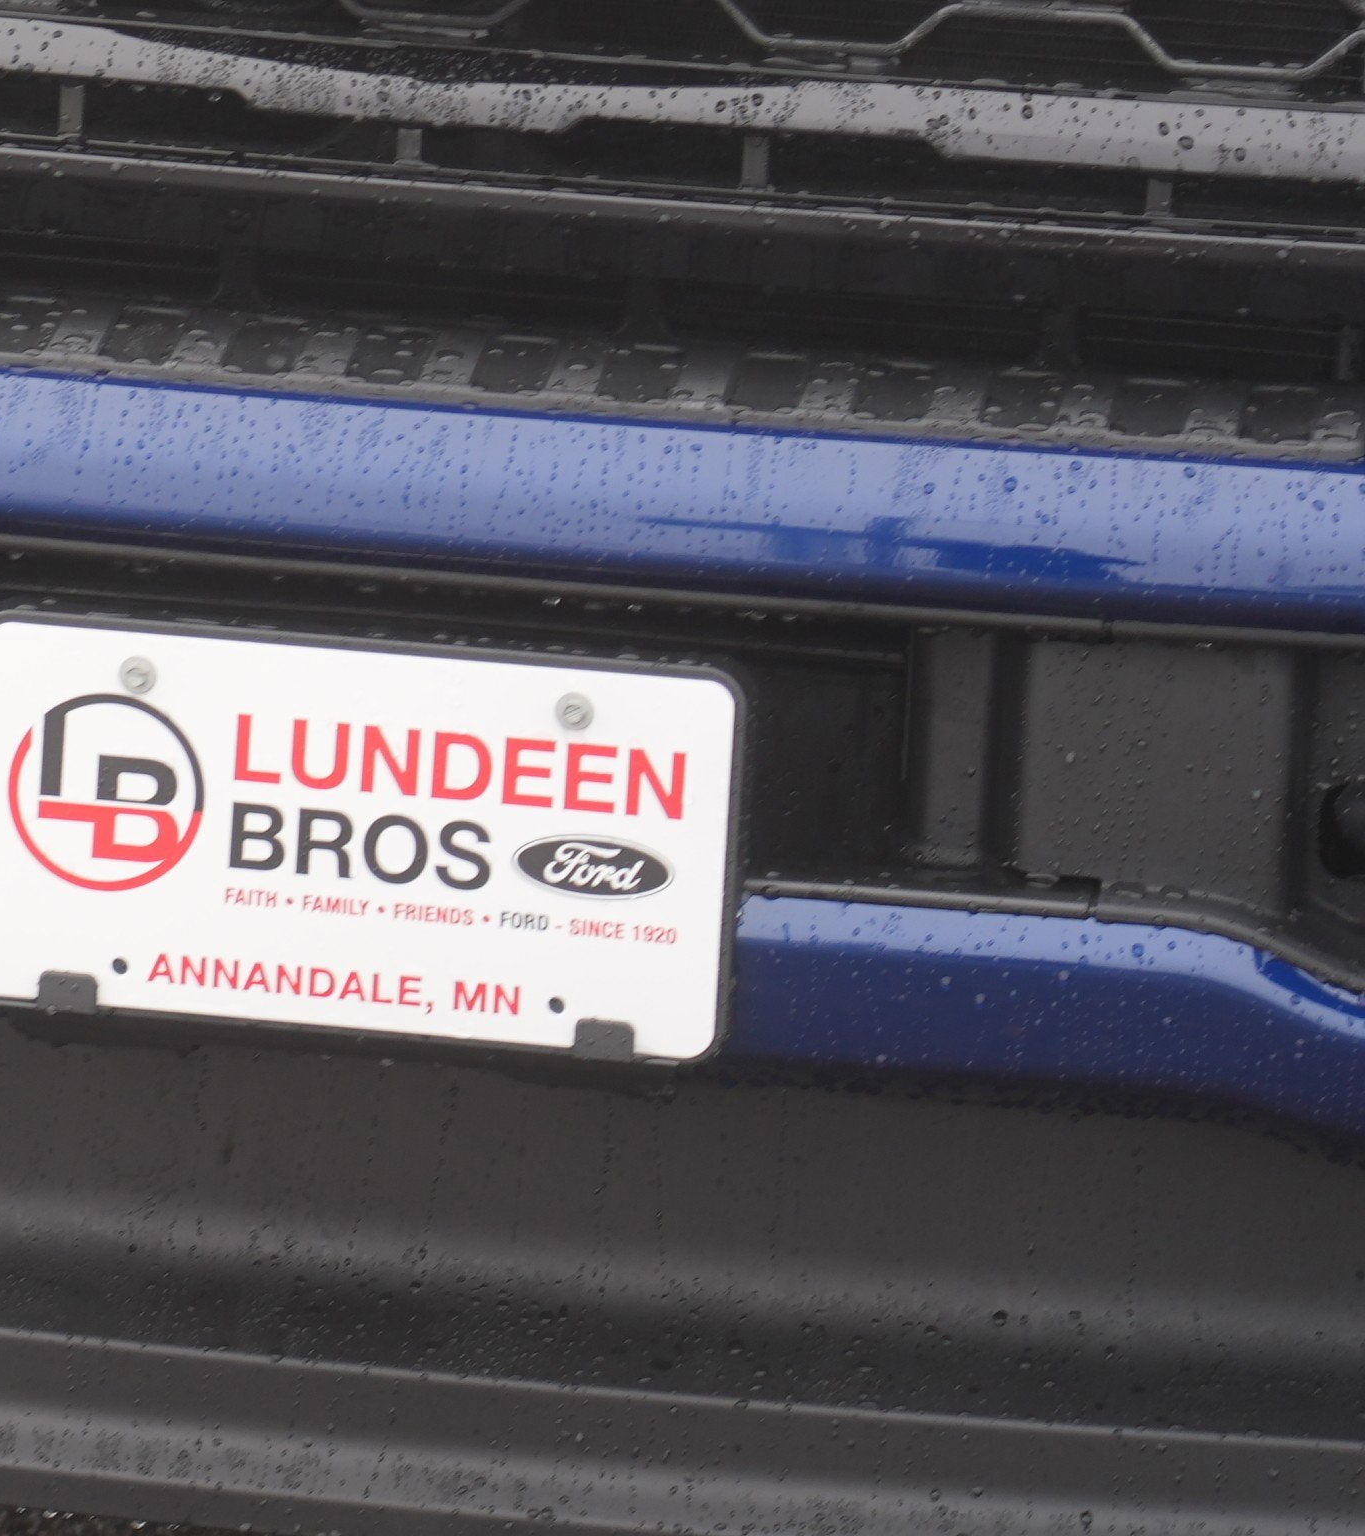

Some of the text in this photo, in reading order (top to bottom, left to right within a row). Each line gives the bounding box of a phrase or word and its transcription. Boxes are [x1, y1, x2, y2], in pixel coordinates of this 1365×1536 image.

[232, 713, 688, 820] LUNDEEN
[227, 801, 492, 892] BROS
[542, 841, 647, 891] Ford
[225, 887, 278, 907] FAITH
[302, 894, 370, 916] FAMILY
[393, 902, 474, 926] FRIENDS
[499, 911, 549, 931] FORD
[569, 918, 626, 940] SINCE
[633, 925, 677, 944] 1920
[147, 952, 521, 1017] ANNANDALE, MN
